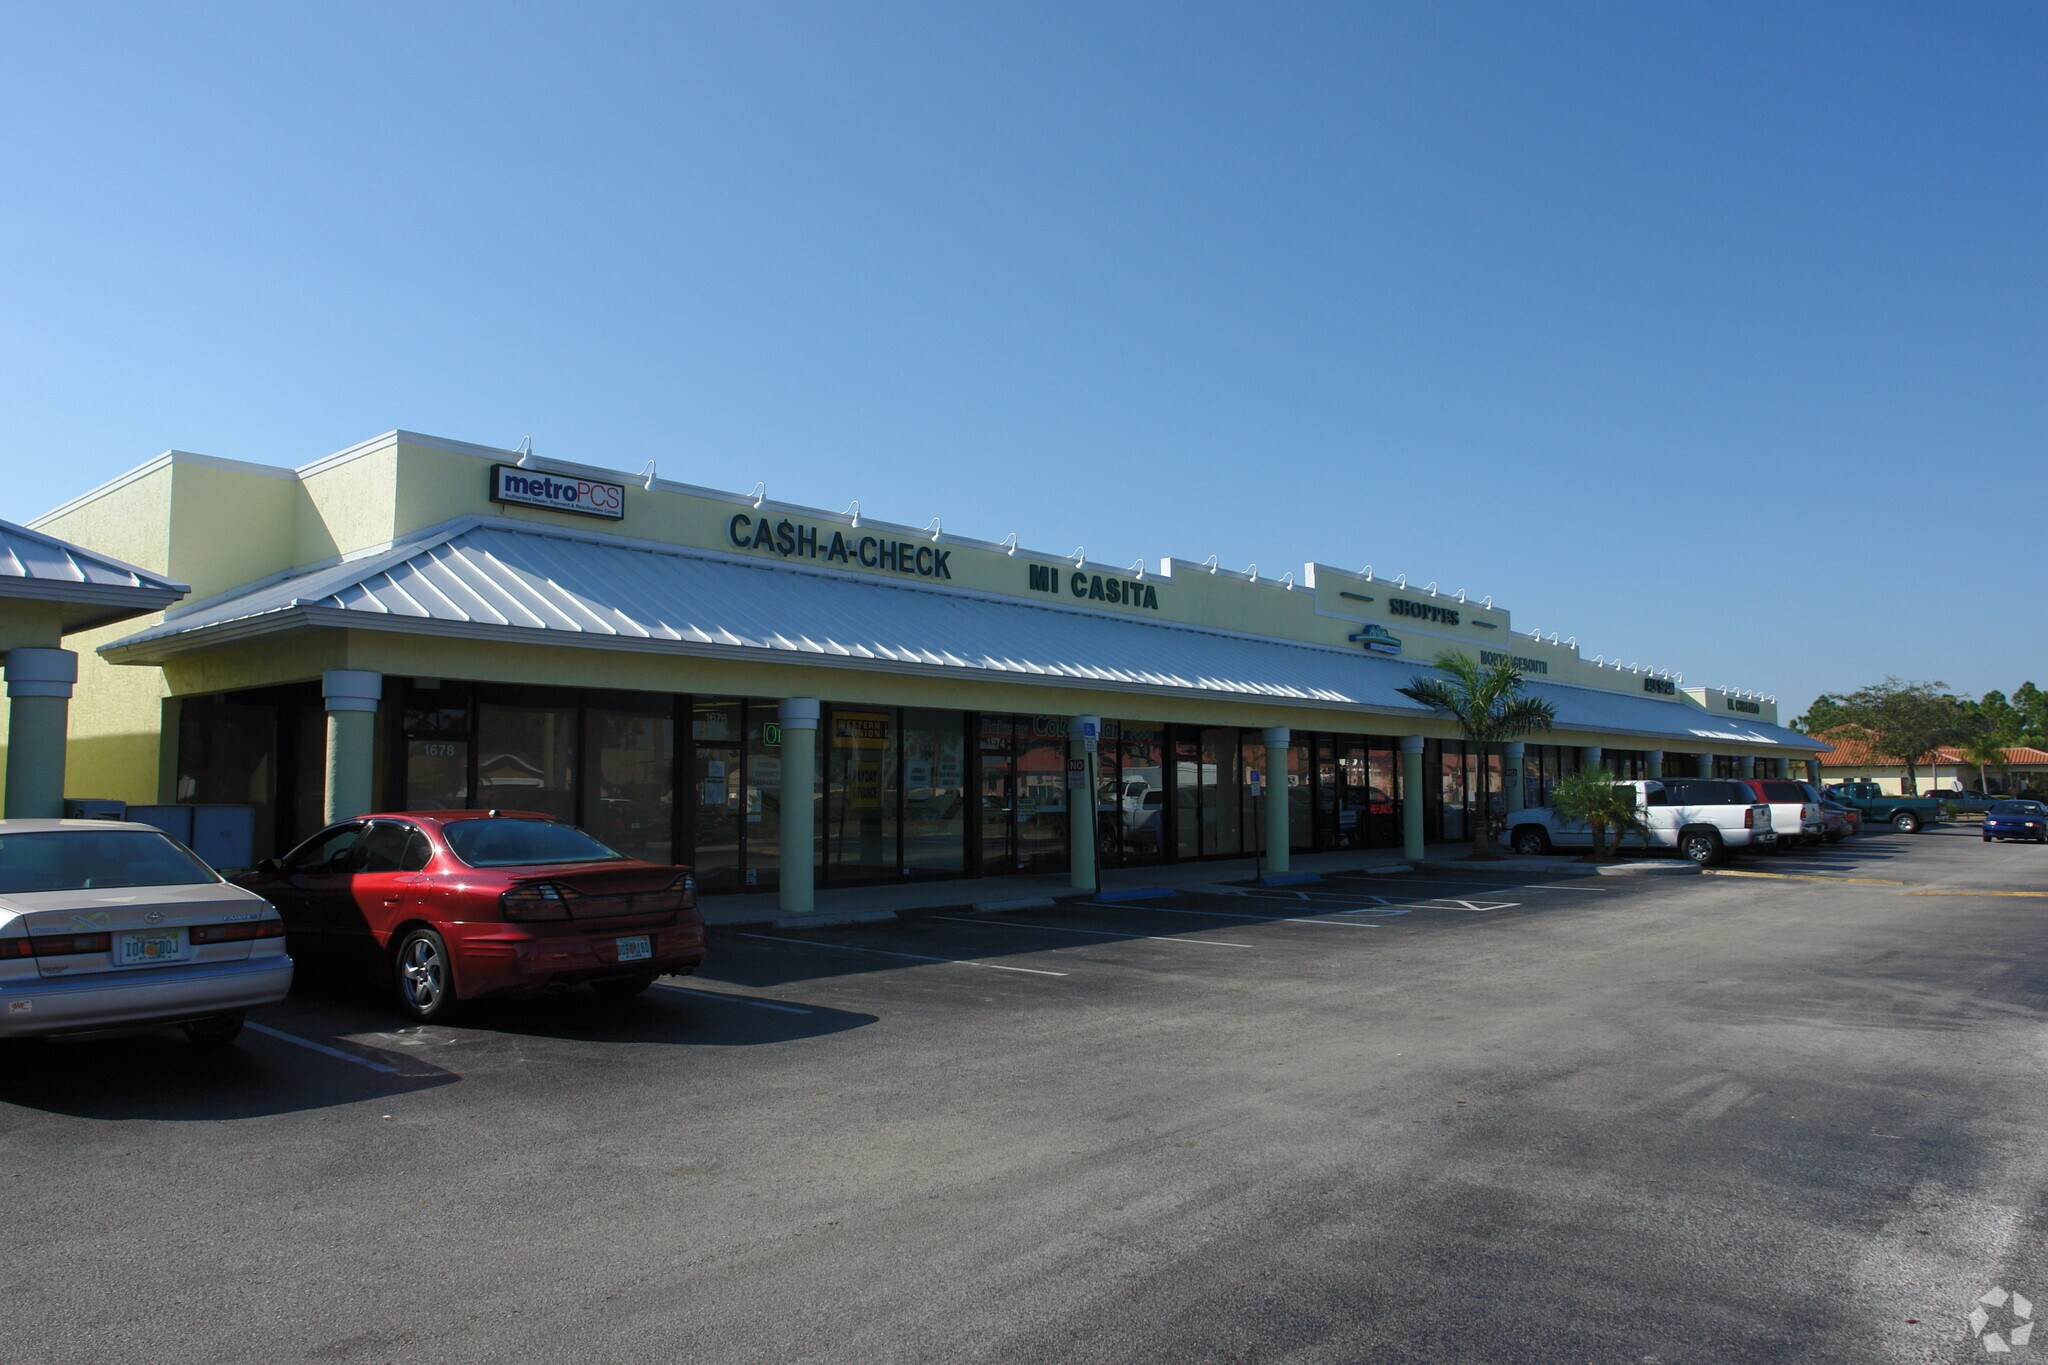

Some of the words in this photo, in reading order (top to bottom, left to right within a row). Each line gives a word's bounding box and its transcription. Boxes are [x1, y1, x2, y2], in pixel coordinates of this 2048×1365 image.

[505, 475, 619, 509] metroPCS
[505, 493, 532, 502] Authorized
[549, 500, 570, 508] Payment
[576, 503, 604, 513] Reactivation
[1029, 564, 1058, 593] MI
[1071, 572, 1159, 610] CASITA
[1389, 598, 1460, 626] SHOPPES
[837, 719, 881, 730] WESTERN
[424, 744, 455, 757] 1678
[1070, 761, 1083, 770] NO
